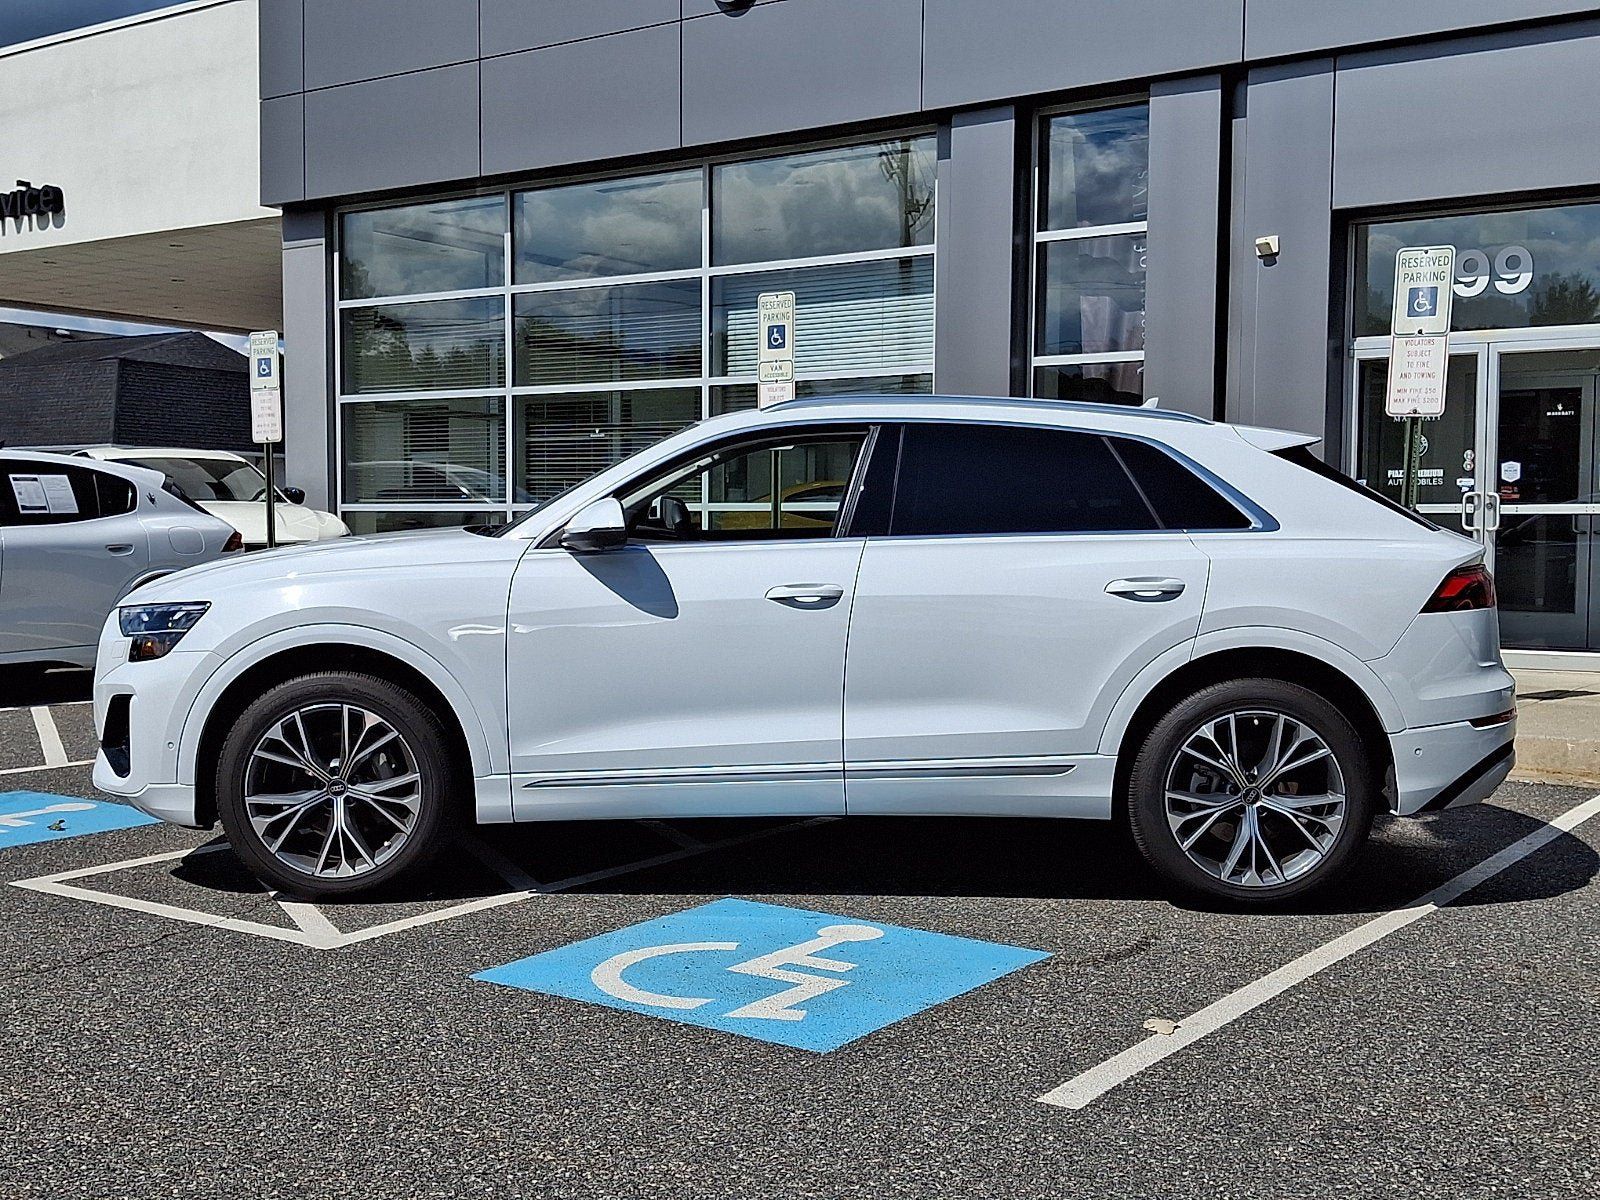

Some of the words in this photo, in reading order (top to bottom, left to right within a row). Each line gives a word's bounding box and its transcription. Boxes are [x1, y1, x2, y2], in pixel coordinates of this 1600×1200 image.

[0, 180, 64, 218] vice
[1401, 255, 1450, 268] RESERVED
[1403, 271, 1446, 283] PARKING
[1453, 246, 1533, 297] 99
[761, 300, 791, 310] RESERVED
[763, 311, 791, 322] PARKING
[252, 337, 275, 345] RESERVED
[1405, 338, 1435, 346] VIOLATORS
[1407, 349, 1431, 357] SUBJECT
